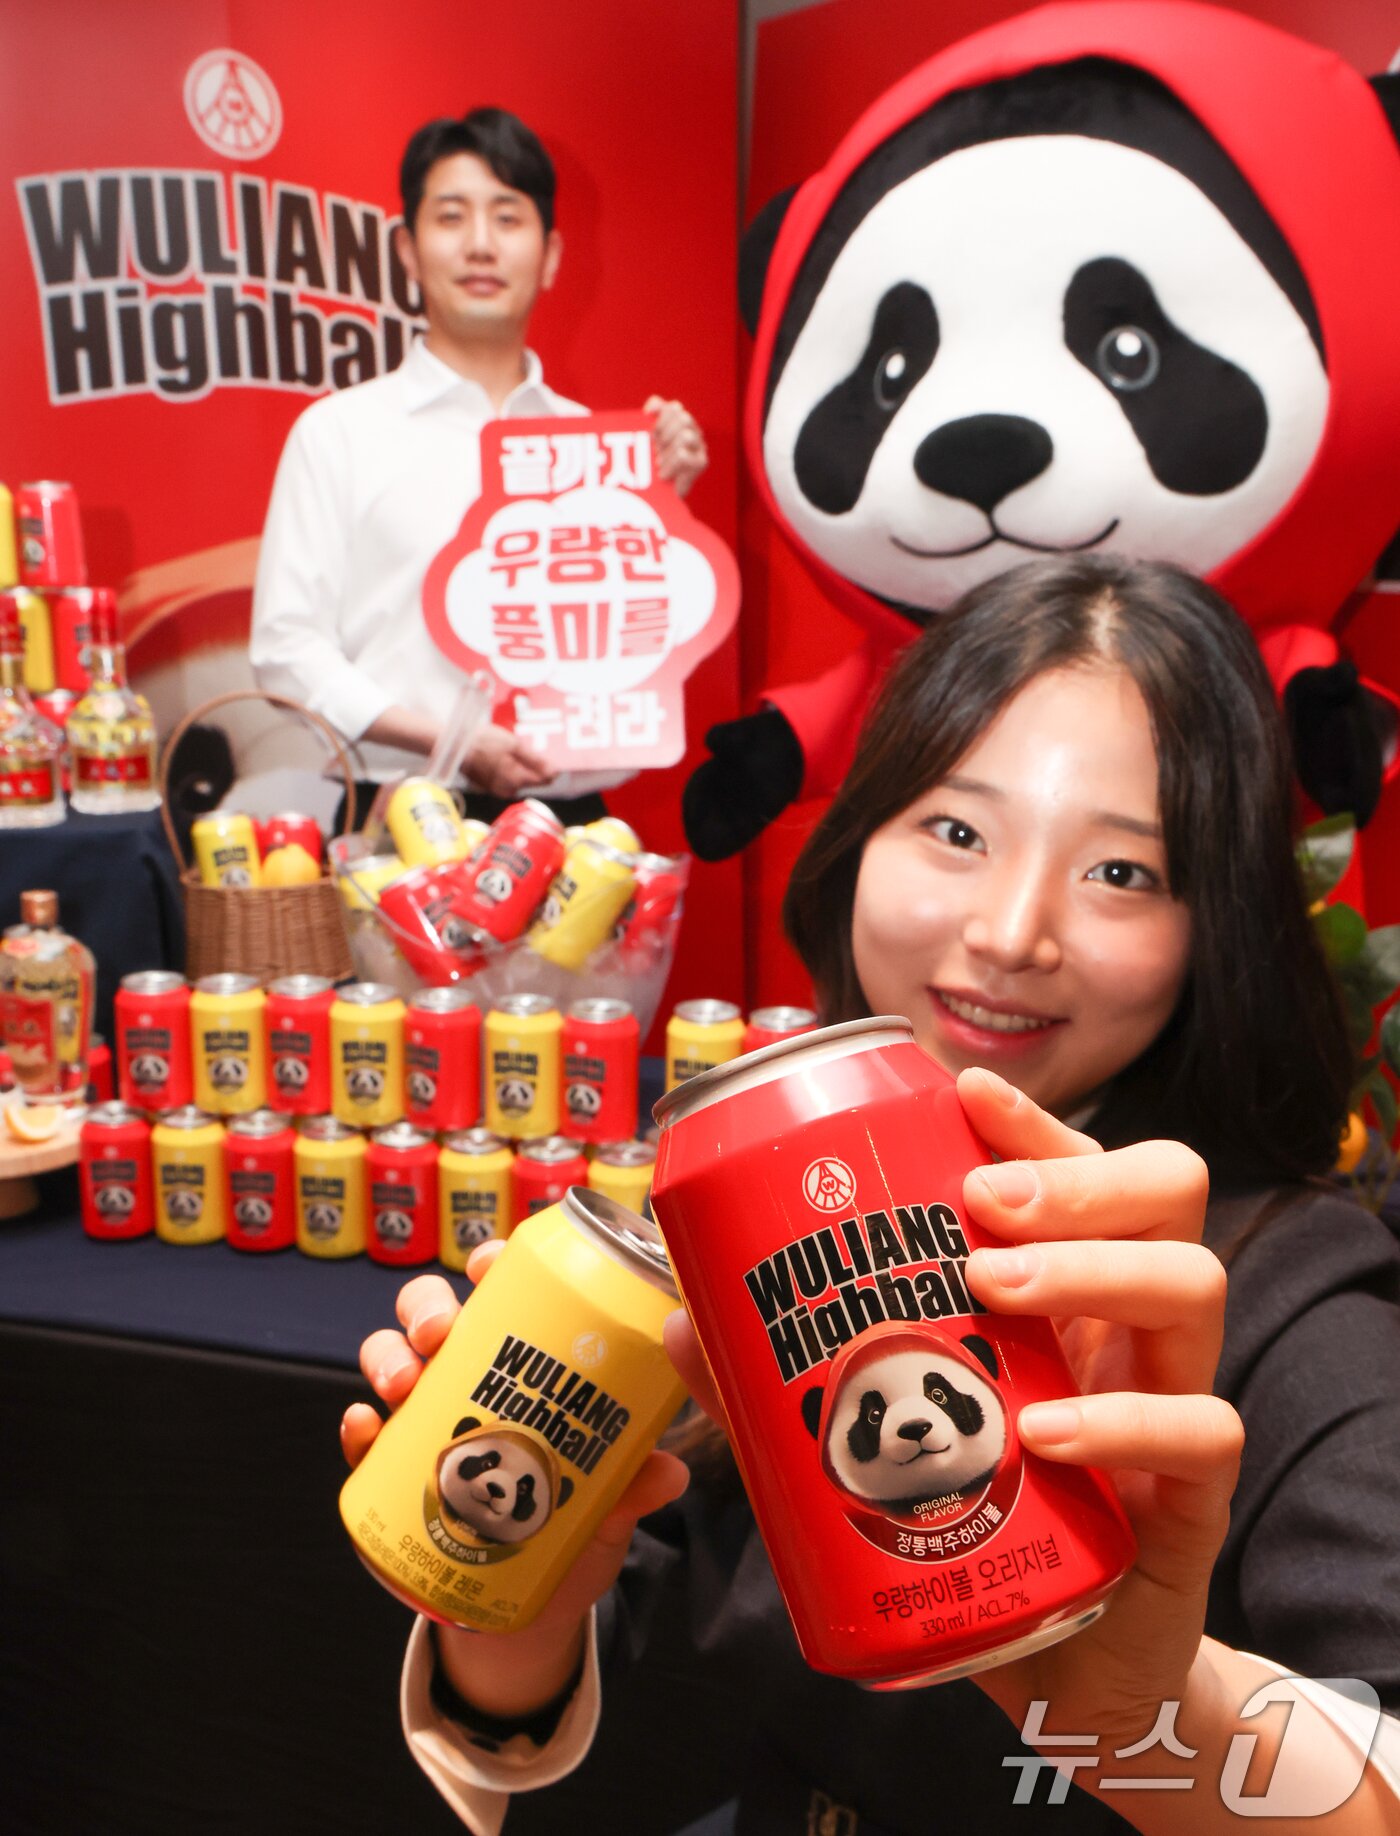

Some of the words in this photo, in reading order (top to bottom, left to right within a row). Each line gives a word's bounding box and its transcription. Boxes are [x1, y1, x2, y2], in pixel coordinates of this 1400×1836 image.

[500, 432, 652, 495] 끝까지
[489, 523, 667, 589] 우량한
[490, 597, 670, 662] 풍미를
[514, 690, 667, 751] 누려라
[744, 1202, 971, 1326] WULIANG
[492, 1335, 631, 1446] WULIANG
[470, 1368, 609, 1477] Highball
[896, 1501, 1003, 1557] 정통백주하이볼
[913, 1491, 964, 1515] ORIGINAL
[920, 1502, 963, 1523] FLAVOR
[398, 1534, 458, 1586] 우량하이볼
[872, 1565, 976, 1623] 우량하이볼
[978, 1533, 1063, 1591] 오리지널
[920, 1616, 946, 1639] 330
